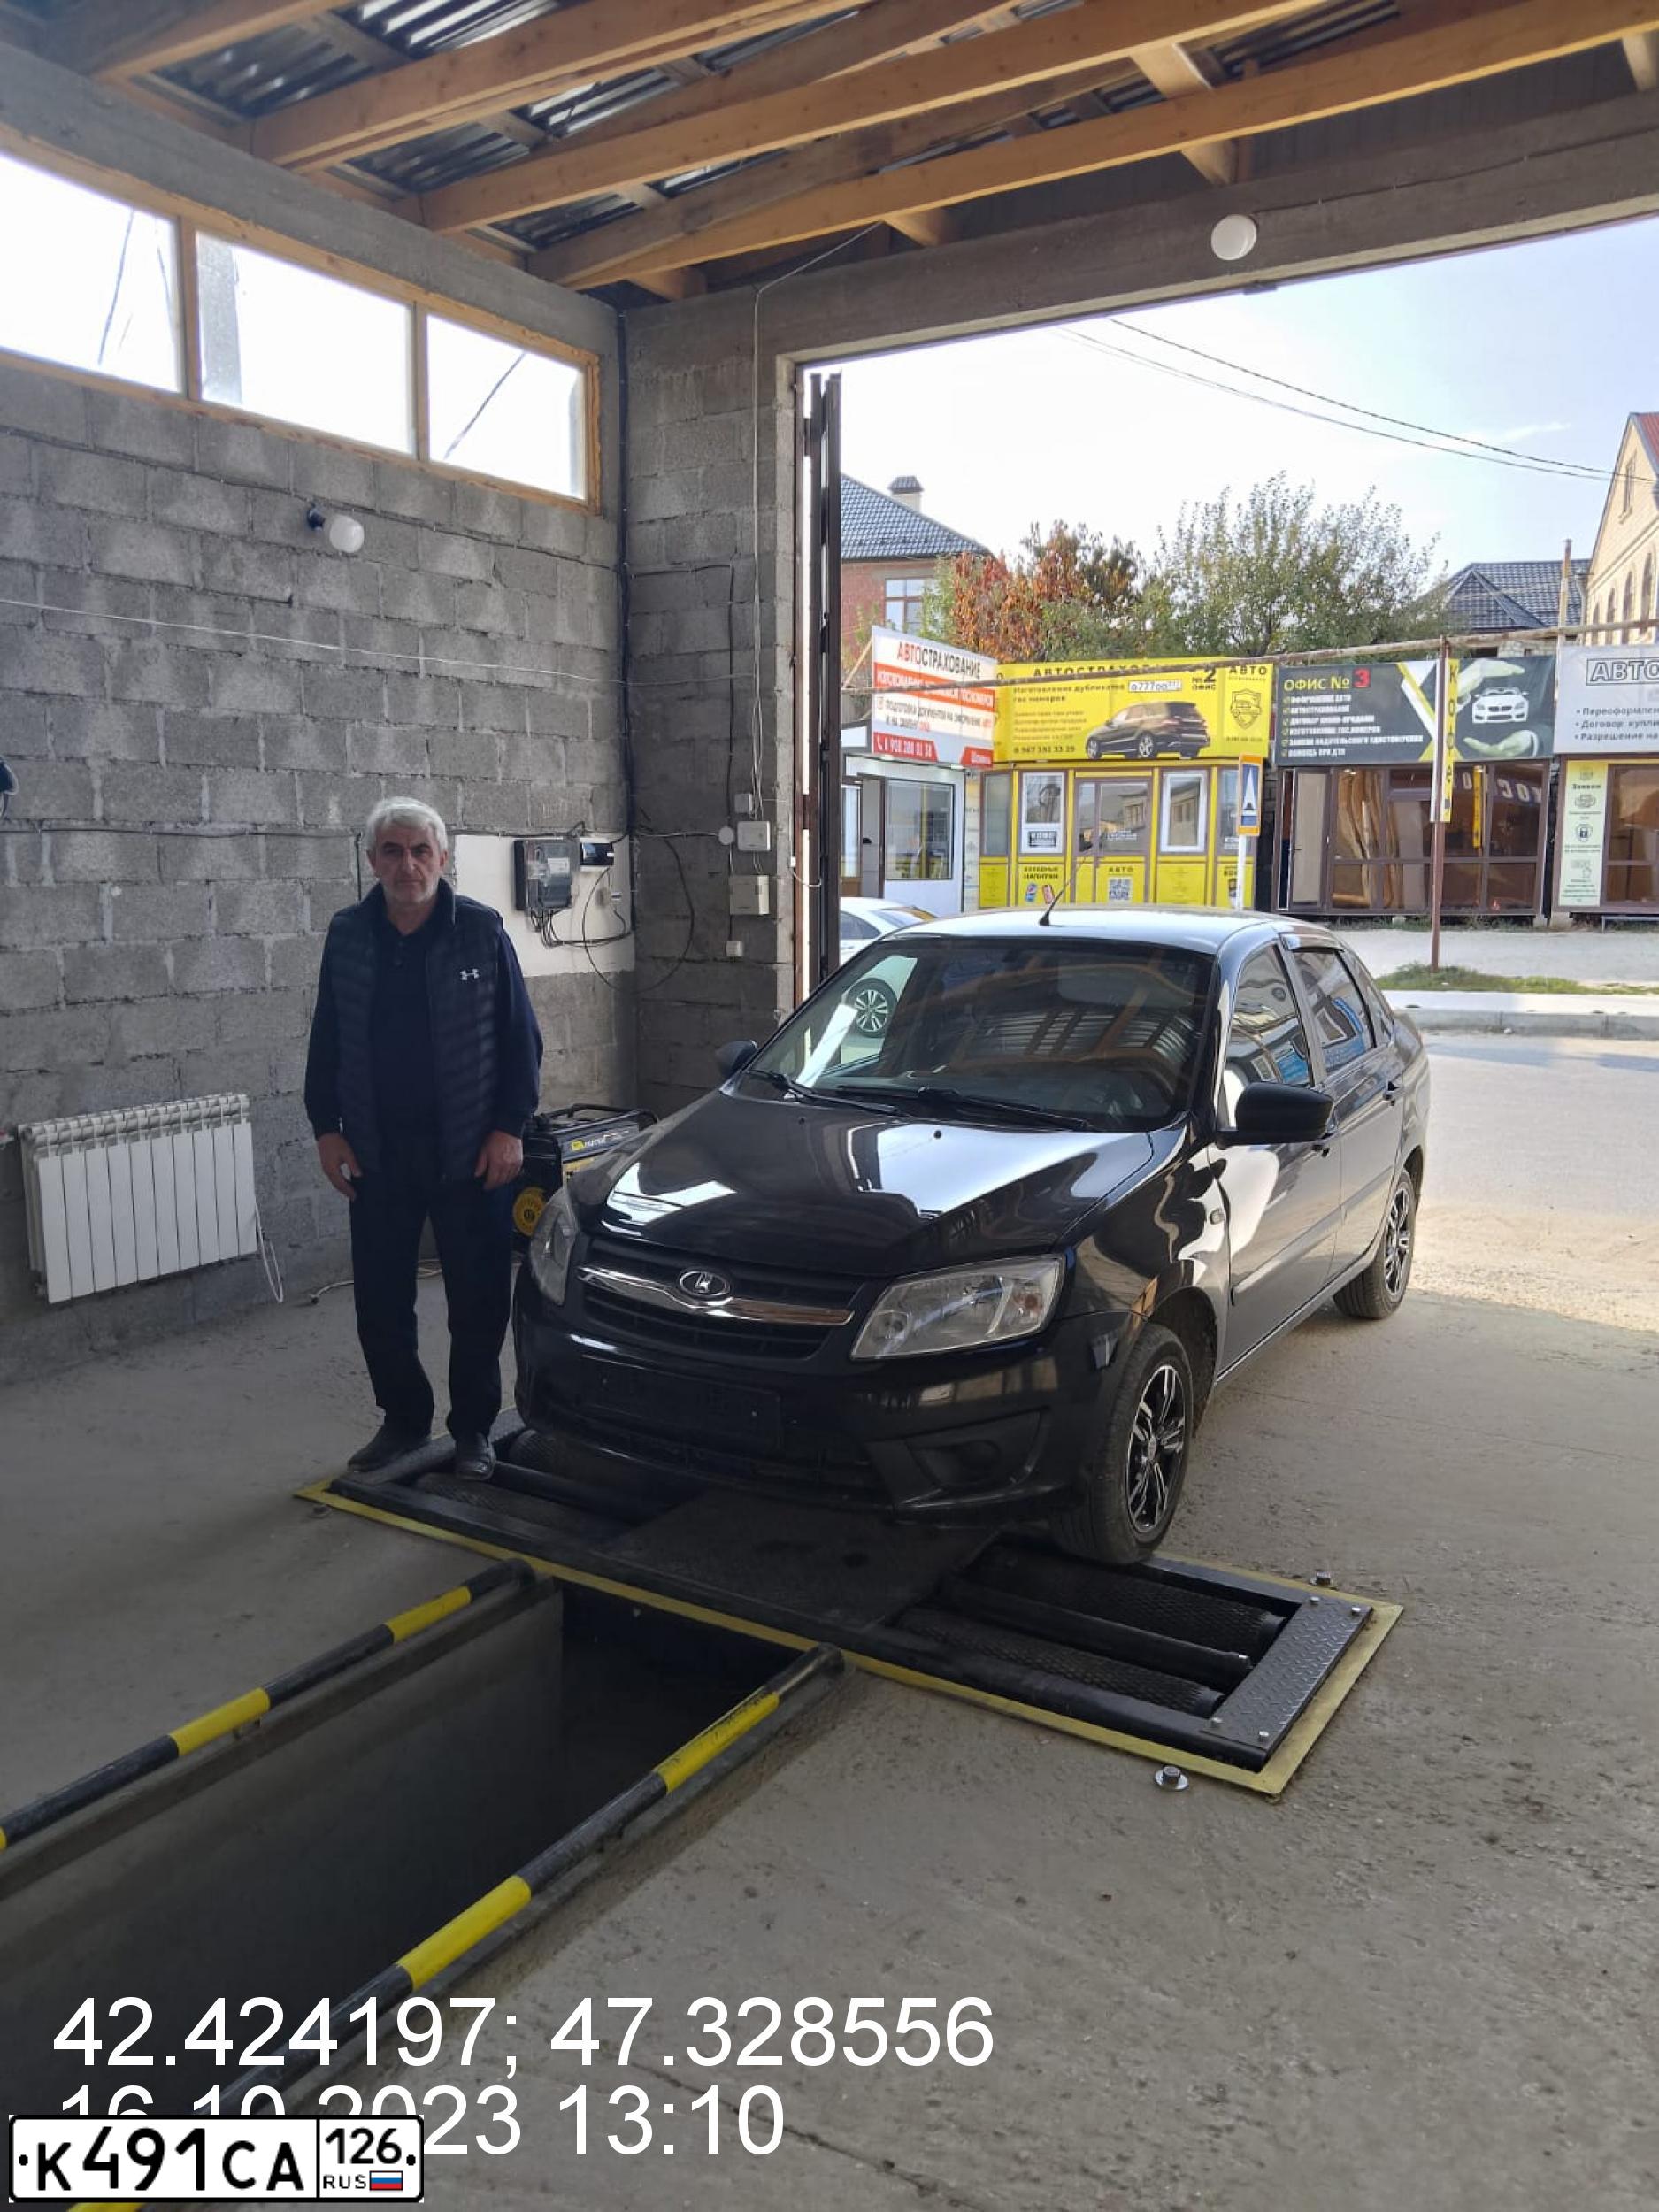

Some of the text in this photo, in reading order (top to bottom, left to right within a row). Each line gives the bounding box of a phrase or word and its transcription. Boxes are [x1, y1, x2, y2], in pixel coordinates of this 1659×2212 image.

[897, 641, 981, 680] АВТОСТРАХОВАНИЕ
[1284, 678, 1326, 691] ОФИС
[1354, 668, 1371, 688] 3
